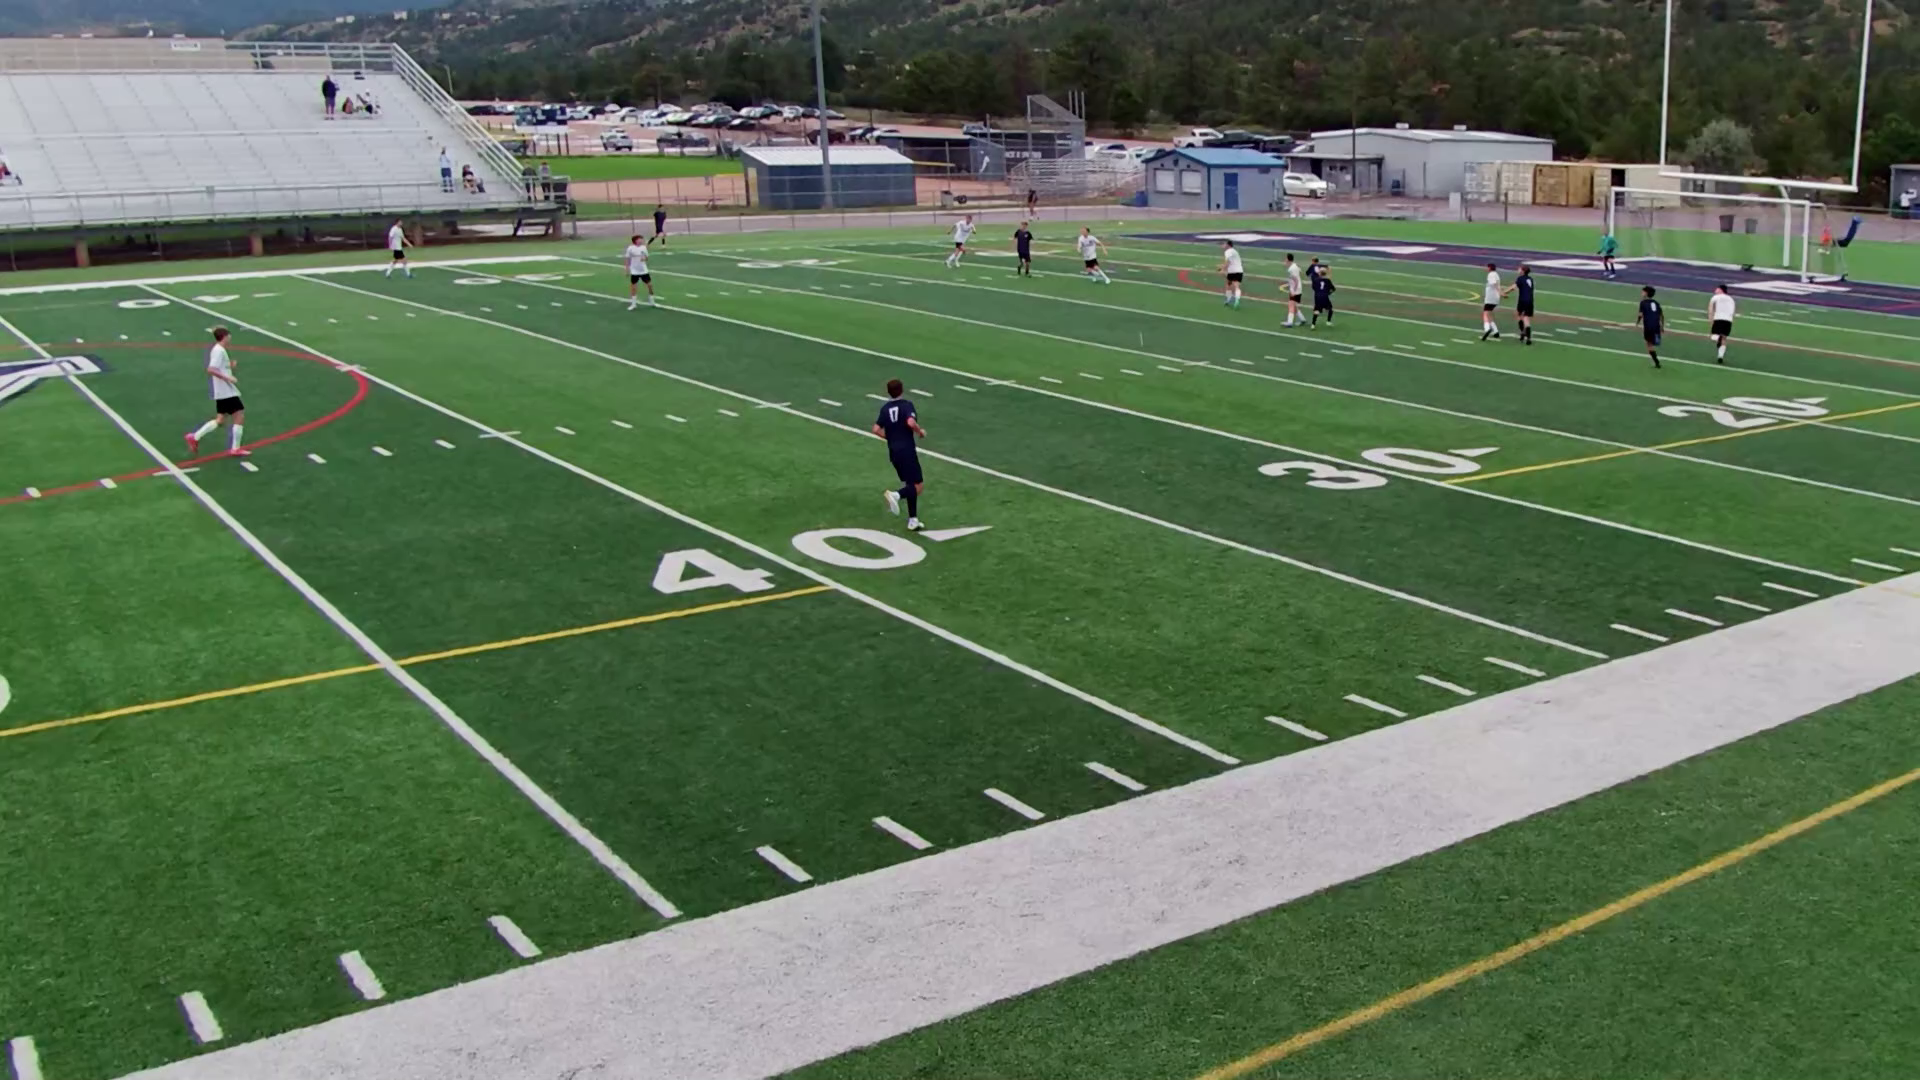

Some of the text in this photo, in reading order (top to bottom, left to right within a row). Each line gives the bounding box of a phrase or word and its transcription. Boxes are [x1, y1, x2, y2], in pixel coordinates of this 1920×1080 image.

[888, 406, 900, 423] 17
[1657, 396, 1828, 429] 20
[1258, 447, 1481, 491] 30
[652, 528, 927, 595] 40
